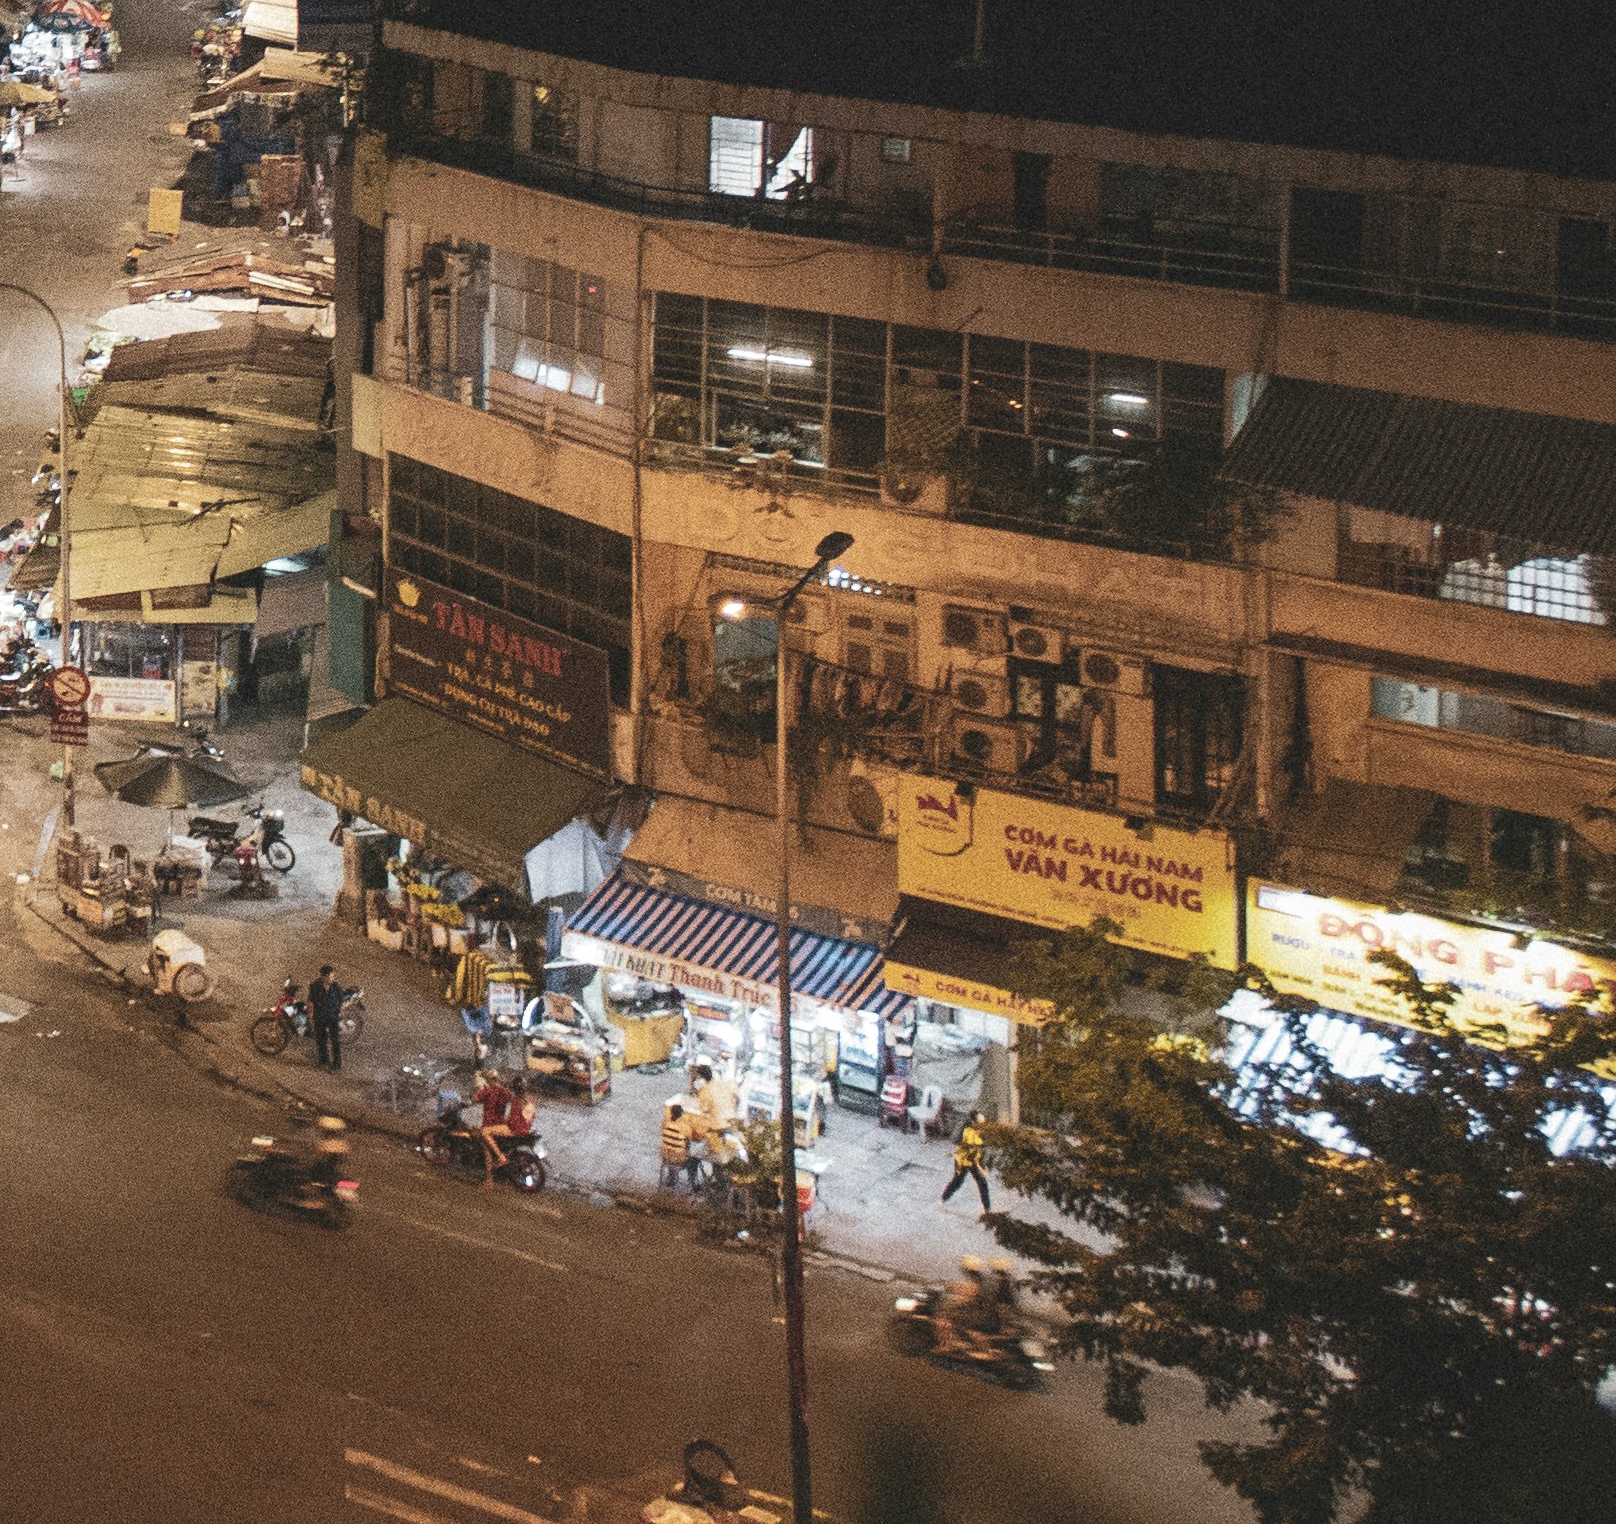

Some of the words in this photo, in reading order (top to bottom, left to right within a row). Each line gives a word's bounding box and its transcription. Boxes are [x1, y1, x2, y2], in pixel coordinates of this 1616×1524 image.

[1063, 836, 1096, 859] GÀ
[1147, 855, 1203, 884] NAM
[1079, 864, 1204, 914] XƯƠNG
[669, 962, 726, 996] Thanh
